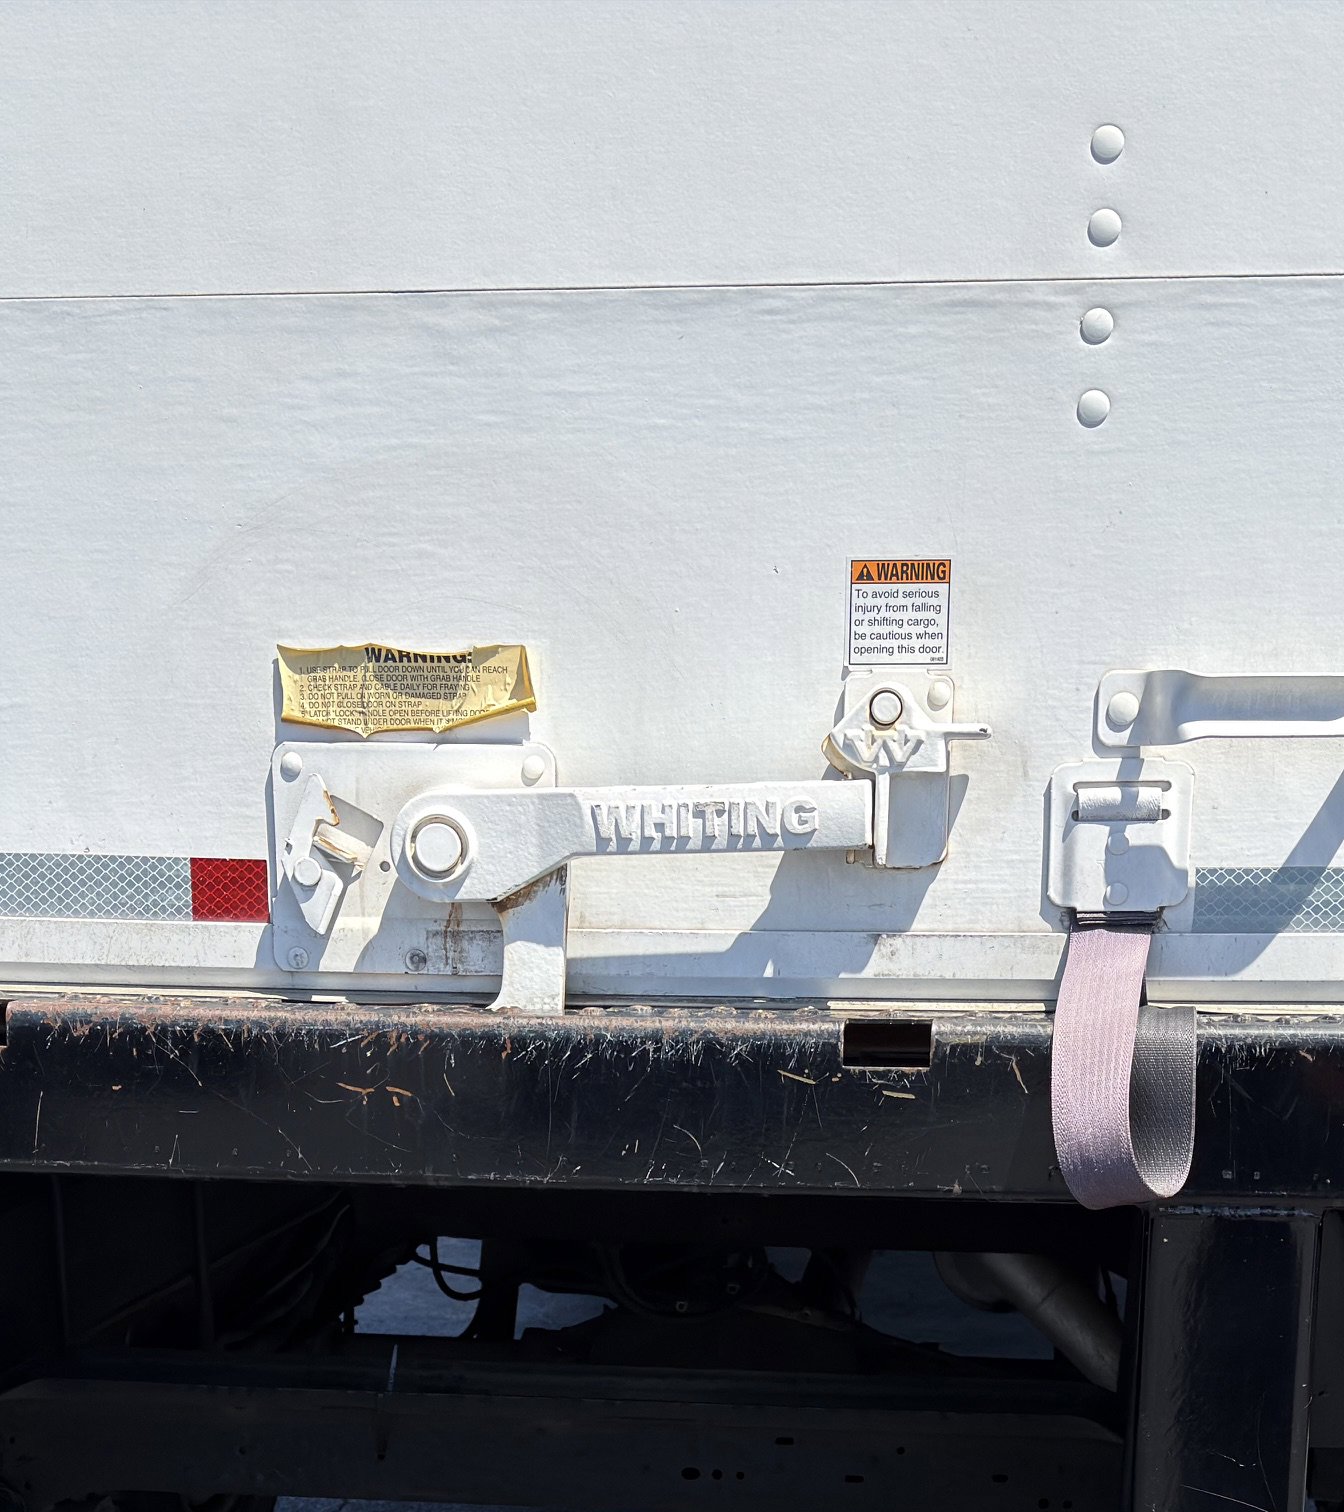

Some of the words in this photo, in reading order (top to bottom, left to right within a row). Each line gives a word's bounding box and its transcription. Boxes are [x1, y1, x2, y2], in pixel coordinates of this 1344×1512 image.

[876, 562, 947, 581] WARNING
[855, 589, 868, 599] To
[871, 589, 899, 599] avoid
[902, 589, 940, 599] serious
[854, 603, 882, 614] injury
[885, 603, 908, 612] from
[911, 603, 942, 614] falling
[854, 618, 865, 626] or
[867, 617, 904, 628] shifting
[906, 618, 939, 628] cargo,
[854, 631, 867, 640] be
[869, 631, 913, 640] cautious
[916, 631, 943, 640] when
[364, 647, 472, 663] WARNING:
[853, 644, 895, 656] opening
[897, 644, 915, 654] this
[918, 644, 944, 654] door.
[374, 683, 398, 691] CABLE
[400, 683, 421, 691] DAILY
[423, 683, 438, 691] FOR
[388, 709, 409, 717] OPEN
[411, 709, 441, 717] BEFORE
[593, 797, 819, 841] WHITING
